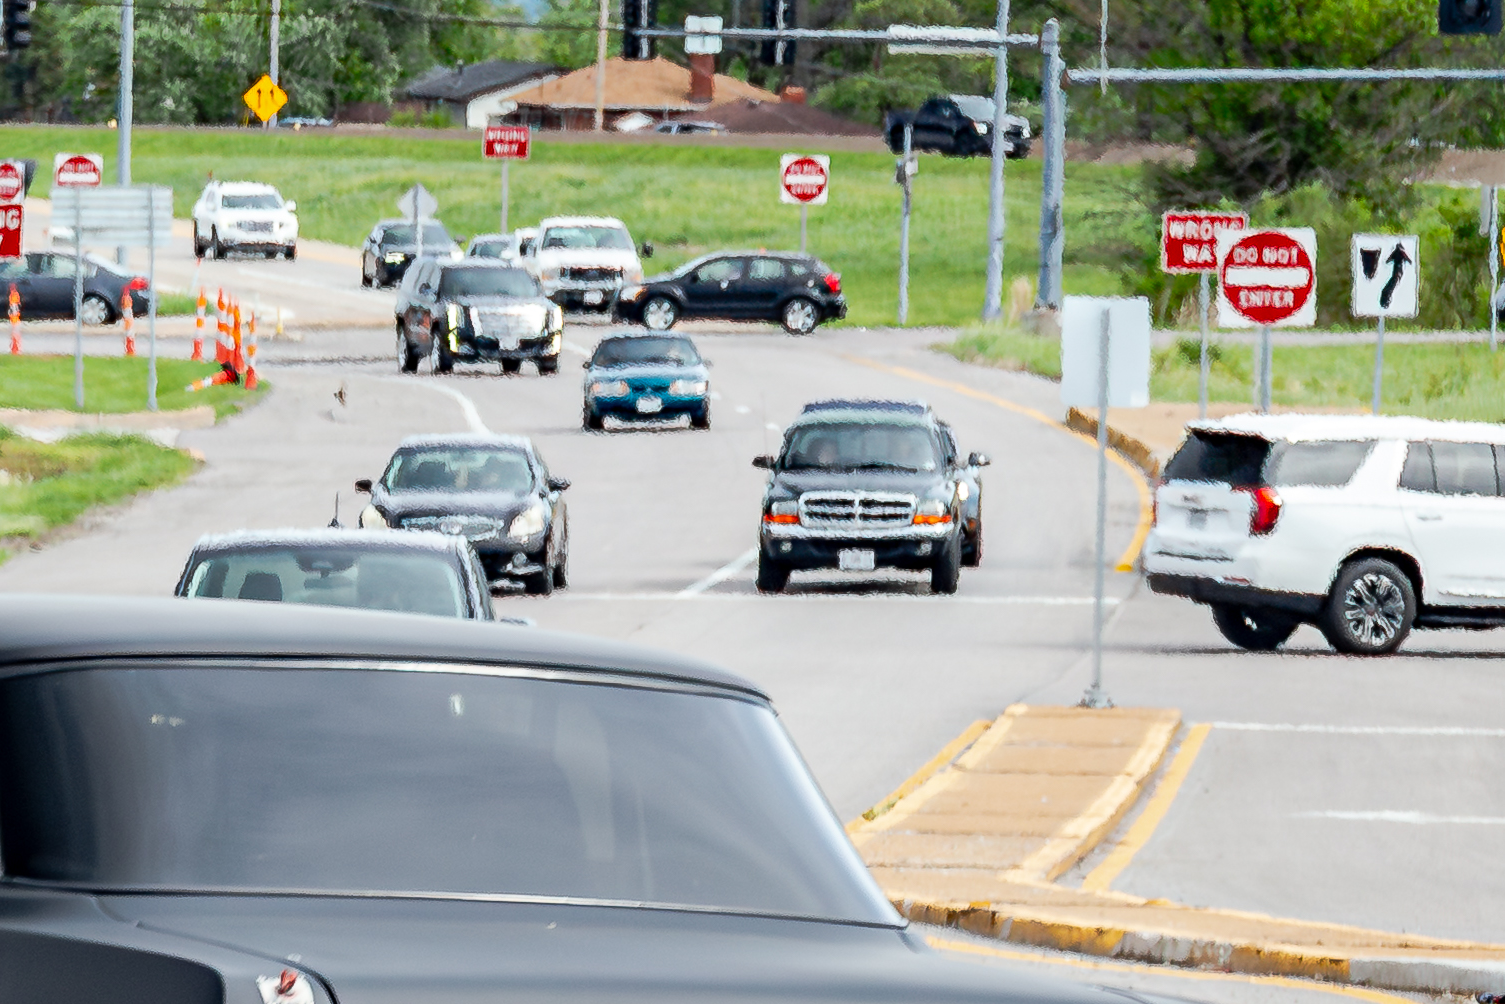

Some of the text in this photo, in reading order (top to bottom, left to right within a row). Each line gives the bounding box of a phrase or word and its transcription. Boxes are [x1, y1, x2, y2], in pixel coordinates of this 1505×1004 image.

[1182, 243, 1217, 264] WA
[1233, 245, 1298, 265] DO NOT
[1238, 290, 1295, 308] ENTER
